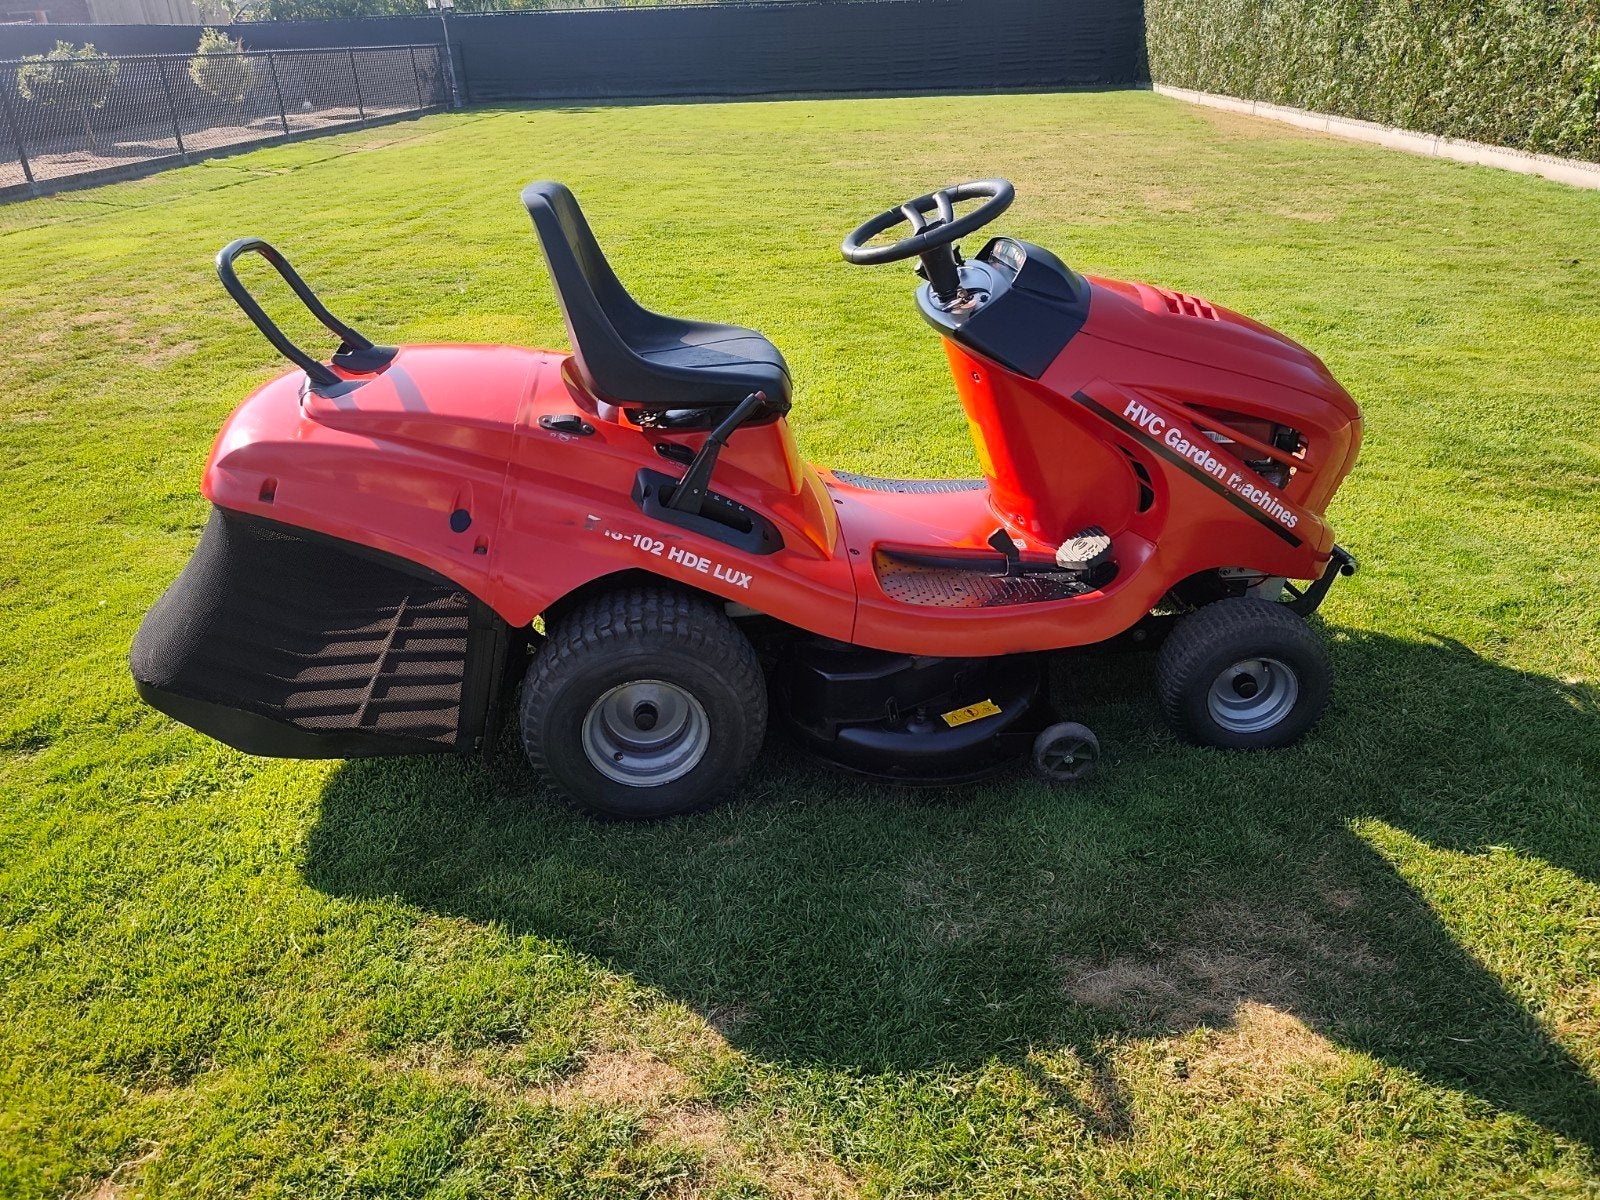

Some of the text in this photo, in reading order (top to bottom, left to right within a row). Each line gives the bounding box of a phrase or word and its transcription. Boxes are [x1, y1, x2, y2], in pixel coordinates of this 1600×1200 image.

[1122, 399, 1299, 529] HVC Garden machines
[667, 546, 712, 574] HDE
[712, 563, 753, 589] LUX
